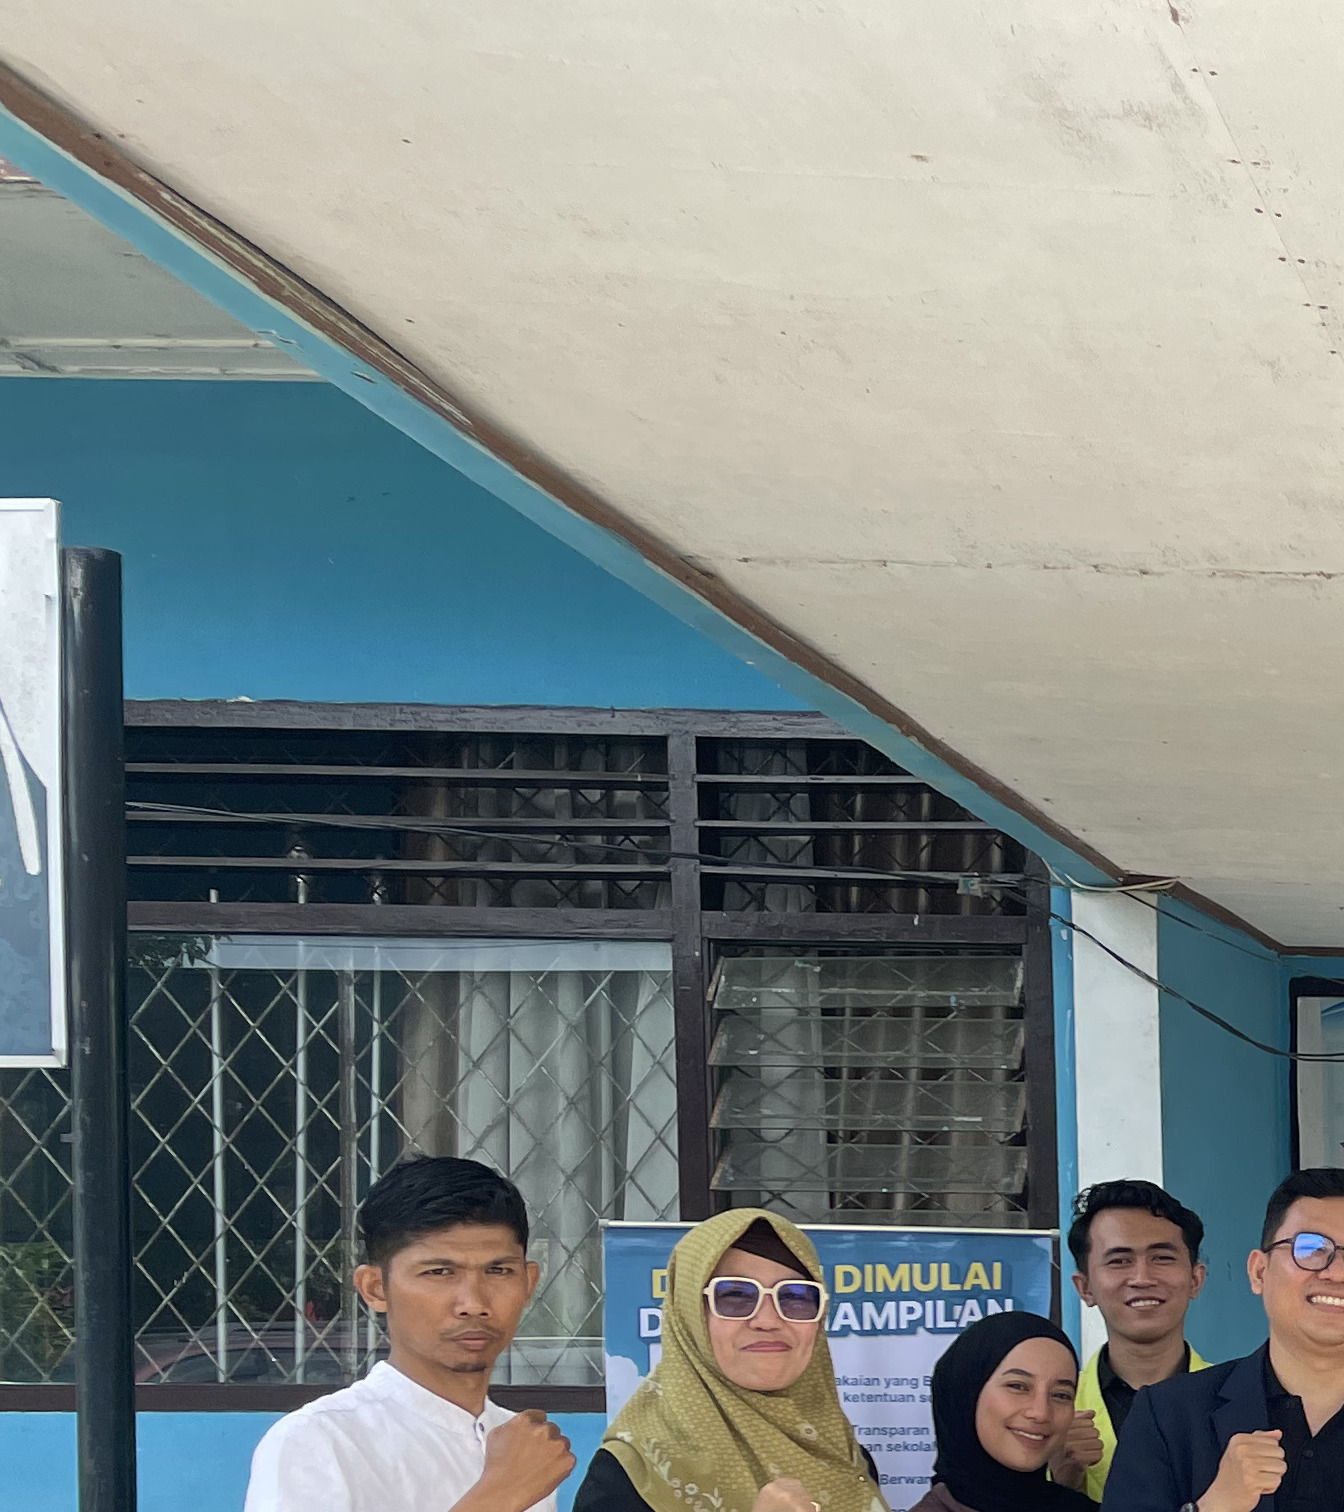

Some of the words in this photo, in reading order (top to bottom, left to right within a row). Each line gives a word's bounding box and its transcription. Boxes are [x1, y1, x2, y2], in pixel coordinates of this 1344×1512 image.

[835, 1262, 1002, 1293] DIMULAI
[824, 1298, 1014, 1332] AMPILAN
[834, 1375, 881, 1387] akaian
[883, 1376, 919, 1390] yang
[843, 1391, 916, 1403] ketentuan
[879, 1473, 932, 1486] Berwar
